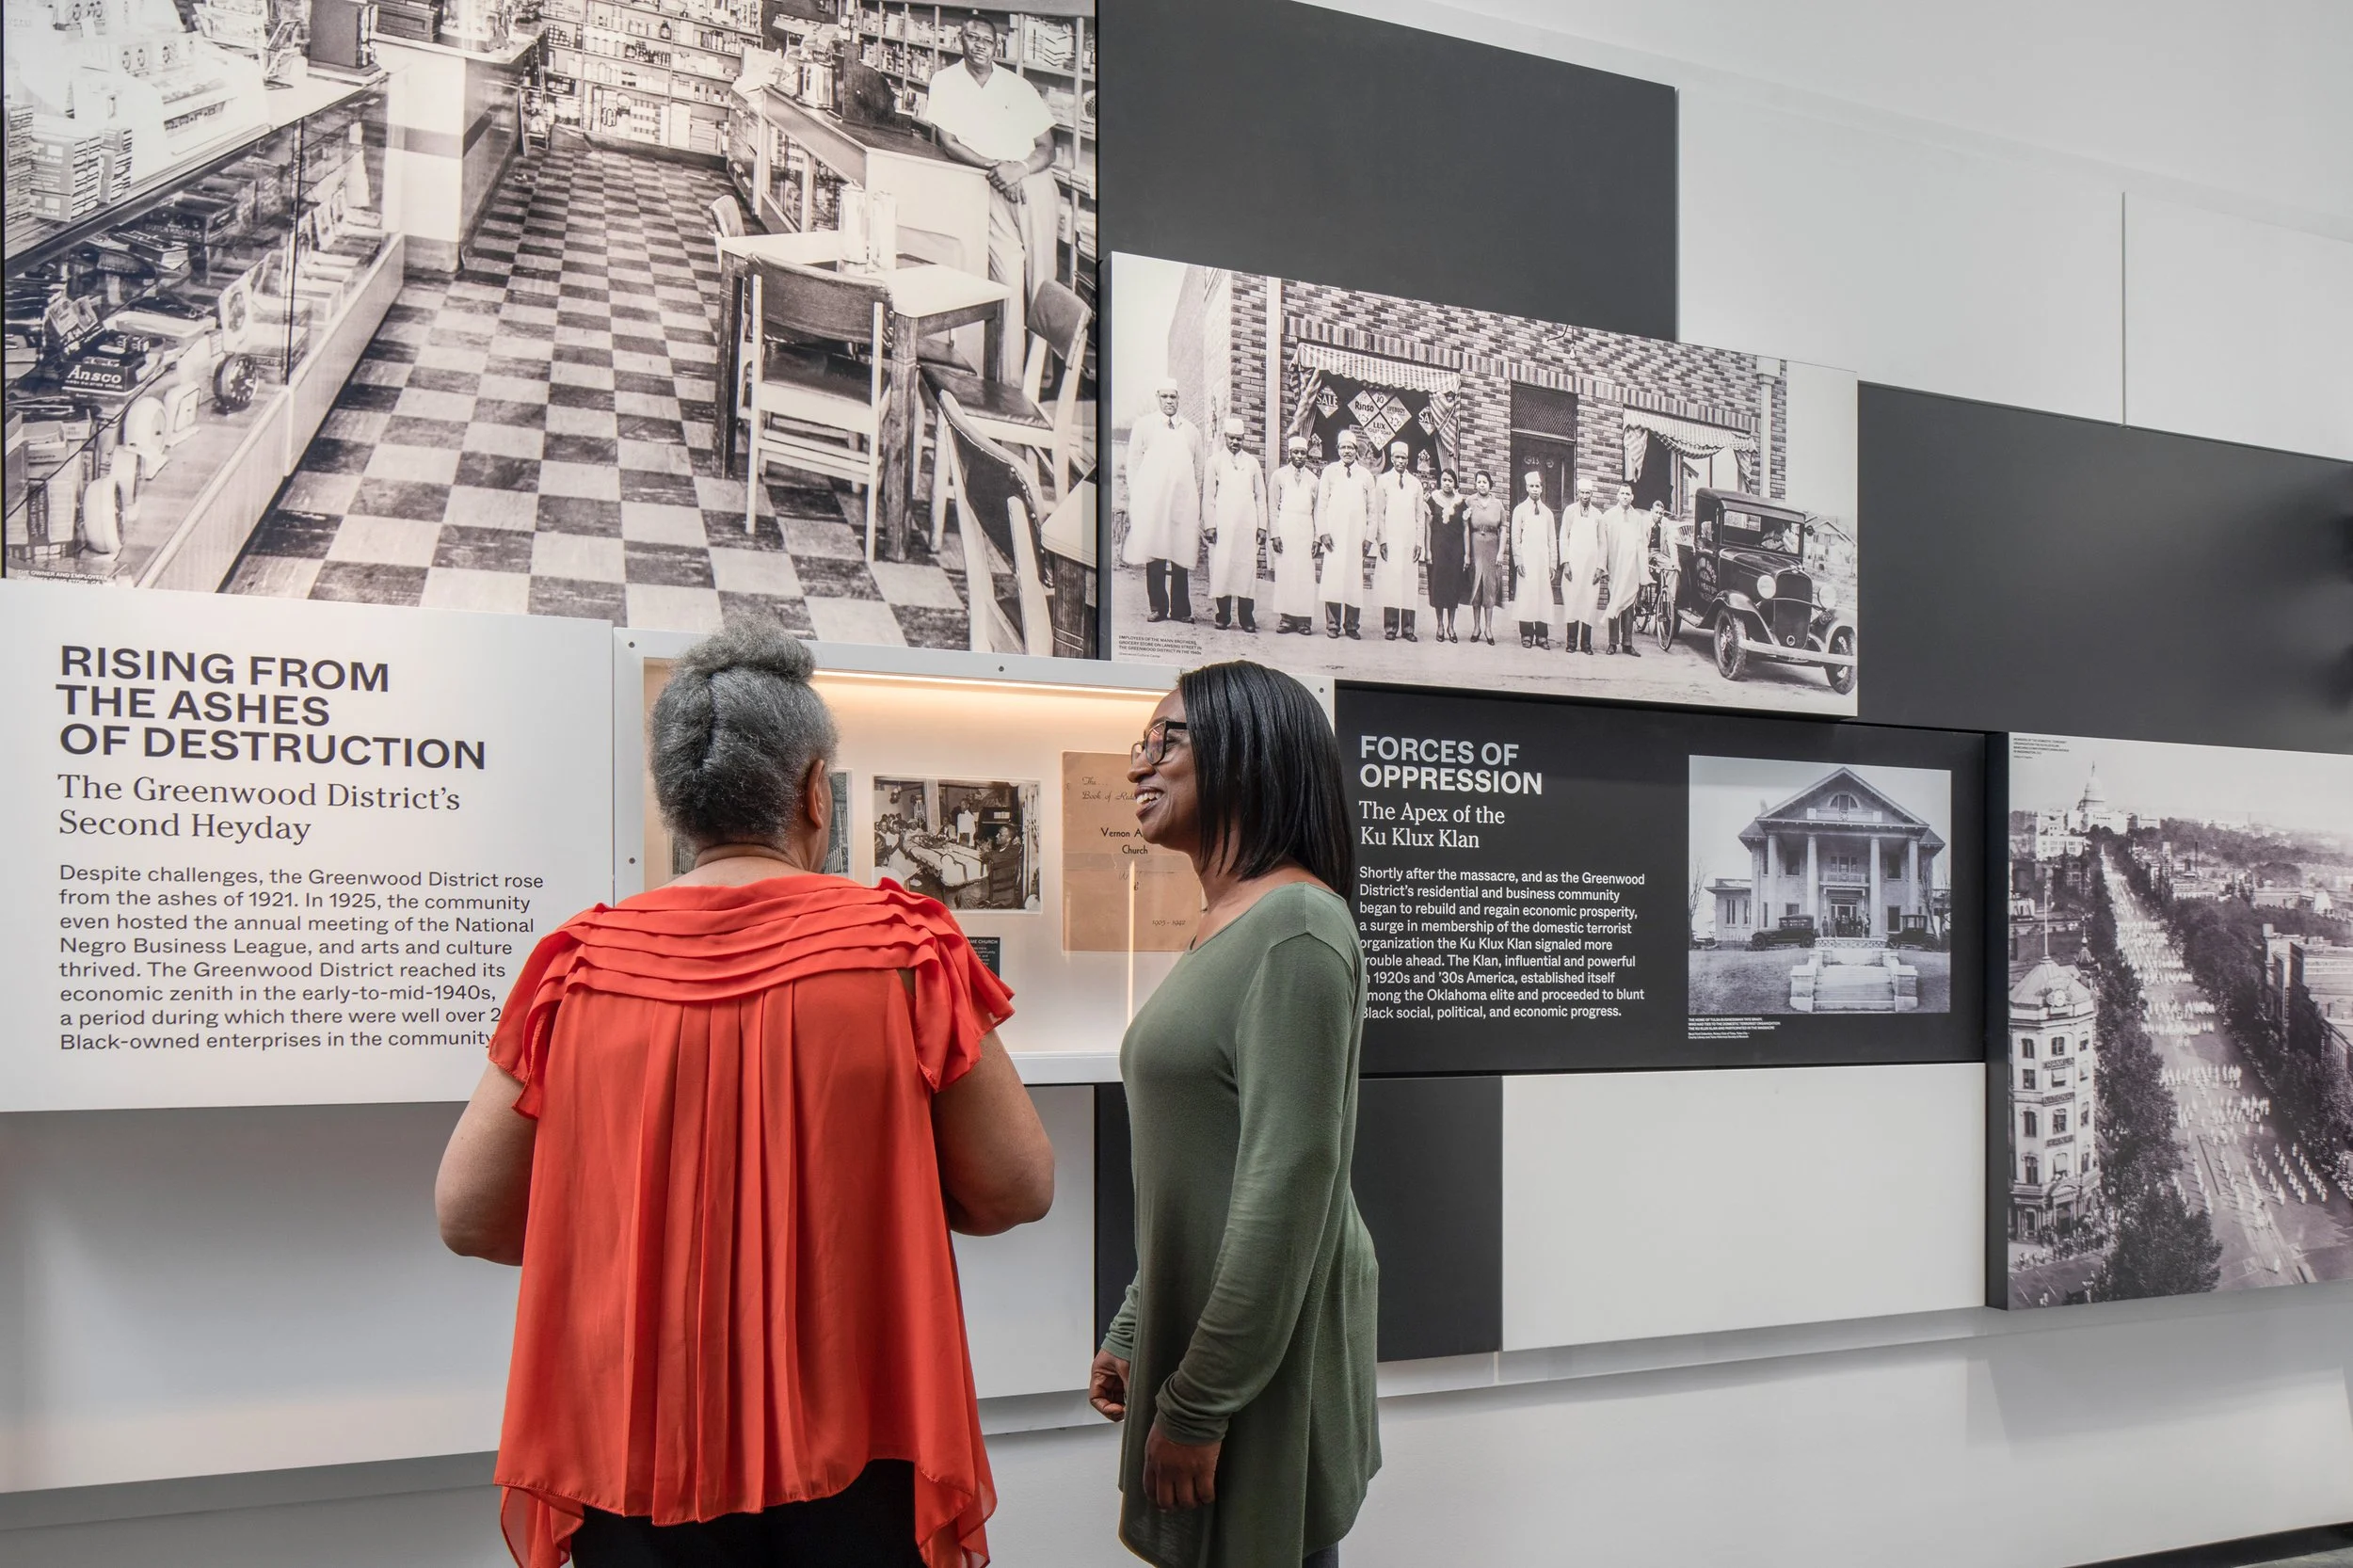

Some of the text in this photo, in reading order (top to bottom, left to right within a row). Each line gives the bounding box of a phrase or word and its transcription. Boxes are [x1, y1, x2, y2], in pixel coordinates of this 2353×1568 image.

[68, 364, 122, 383] Ansco
[1317, 393, 1338, 407] SALE
[1355, 402, 1374, 412] Rinso
[1418, 412, 1433, 423] SAL
[62, 645, 388, 693] RISING FROM
[56, 683, 329, 727] THE ASHES
[60, 723, 485, 770] OF DESTRUCTION
[1361, 735, 1519, 766] FORCES OF
[1360, 763, 1542, 795] OPPRESSION
[57, 774, 122, 800] The
[134, 776, 316, 806] Greenwood
[1358, 800, 1505, 825] The Apex of the
[59, 809, 312, 846] Second Heyday
[1100, 827, 1130, 838] Vernon
[1361, 826, 1480, 848] Ku Klux Klan
[1122, 844, 1148, 855] Church
[60, 864, 543, 888] Despite challenges, the Greenwood District rose
[1359, 866, 1645, 885] Shortly after the massacre, and as the Greenwood
[58, 888, 530, 914] from the ashes of 1921. In 1925, the community
[1417, 885, 1479, 898] residential
[1481, 887, 1503, 899] and
[1506, 887, 1556, 900] business
[1558, 888, 1620, 904] community
[1360, 901, 1638, 920] began to rebuild and regain economic prosperity,
[60, 937, 512, 957] Negro Business League, and arts and culture
[1359, 936, 1613, 952] organization the Ku Klux Klan signaled more
[1365, 954, 1636, 969] rouble ahead. The Klan, influential and powerful
[1373, 971, 1410, 984] 1920s
[1413, 971, 1435, 984] and
[1466, 971, 1518, 985] America,
[1521, 971, 1584, 984] established
[1588, 971, 1615, 984] itself
[60, 984, 495, 1004] economic zenith in the early-to-mid-1940s,
[1367, 988, 1645, 1004] mong the Oklahoma elite and proceeded to blunt
[60, 1014, 73, 1026] a
[80, 1010, 145, 1030] period
[152, 1009, 218, 1029] during
[224, 1009, 284, 1024] which
[290, 1009, 343, 1024] there
[348, 1012, 396, 1023] were
[402, 1008, 440, 1023] well
[445, 1011, 486, 1023] over
[1396, 1006, 1433, 1020] social,
[1437, 1005, 1486, 1021] political,
[1489, 1005, 1511, 1017] and
[1513, 1005, 1568, 1017] economic
[1571, 1007, 1622, 1019] progress.
[61, 1032, 200, 1049] Black-owned
[206, 1032, 321, 1051] enterprises
[328, 1032, 344, 1047] in
[350, 1032, 382, 1047] the
